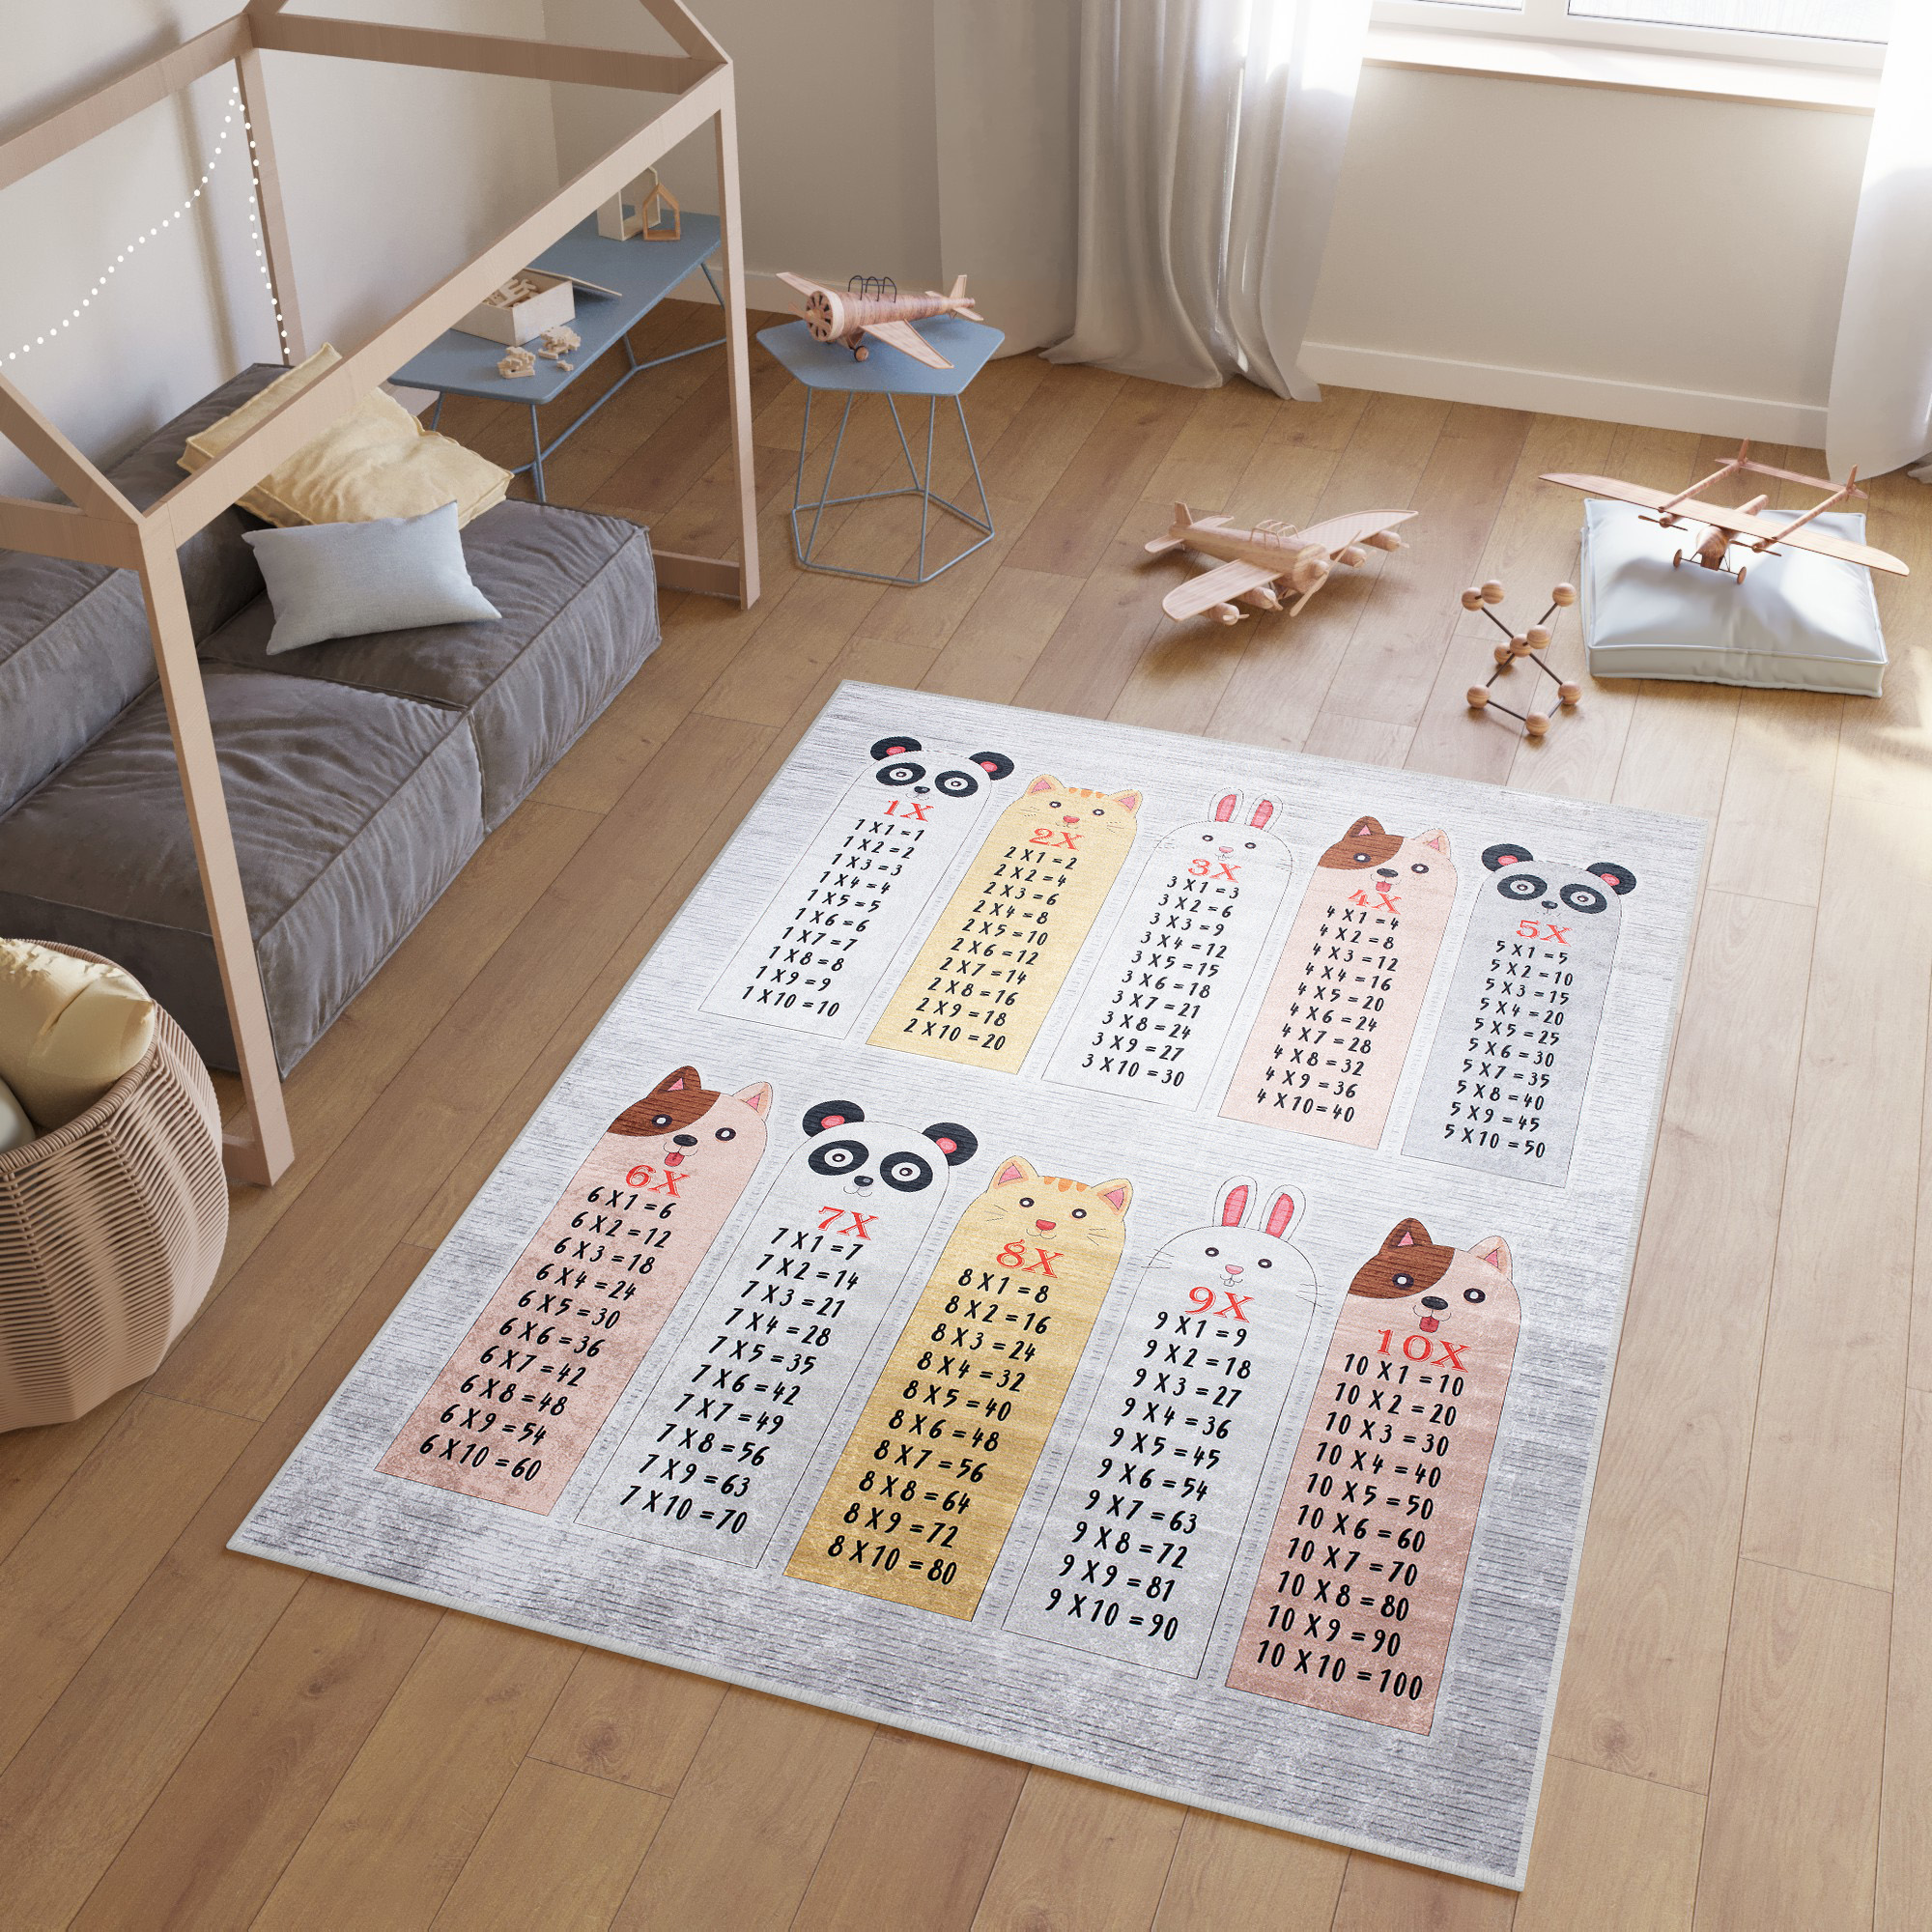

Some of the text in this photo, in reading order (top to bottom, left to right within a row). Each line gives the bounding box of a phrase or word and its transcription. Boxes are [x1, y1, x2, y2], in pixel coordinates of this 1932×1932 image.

[882, 798, 935, 823] 1X
[1027, 827, 1084, 851] 2X
[1186, 857, 1242, 884] 3X
[1346, 888, 1402, 916] 4X
[1514, 918, 1573, 945] 5X
[624, 1163, 691, 1199] 6X
[816, 1205, 880, 1241] 7X
[995, 1237, 1065, 1279] 8X
[1183, 1285, 1254, 1323] 9X
[1376, 1327, 1470, 1374] 10X
